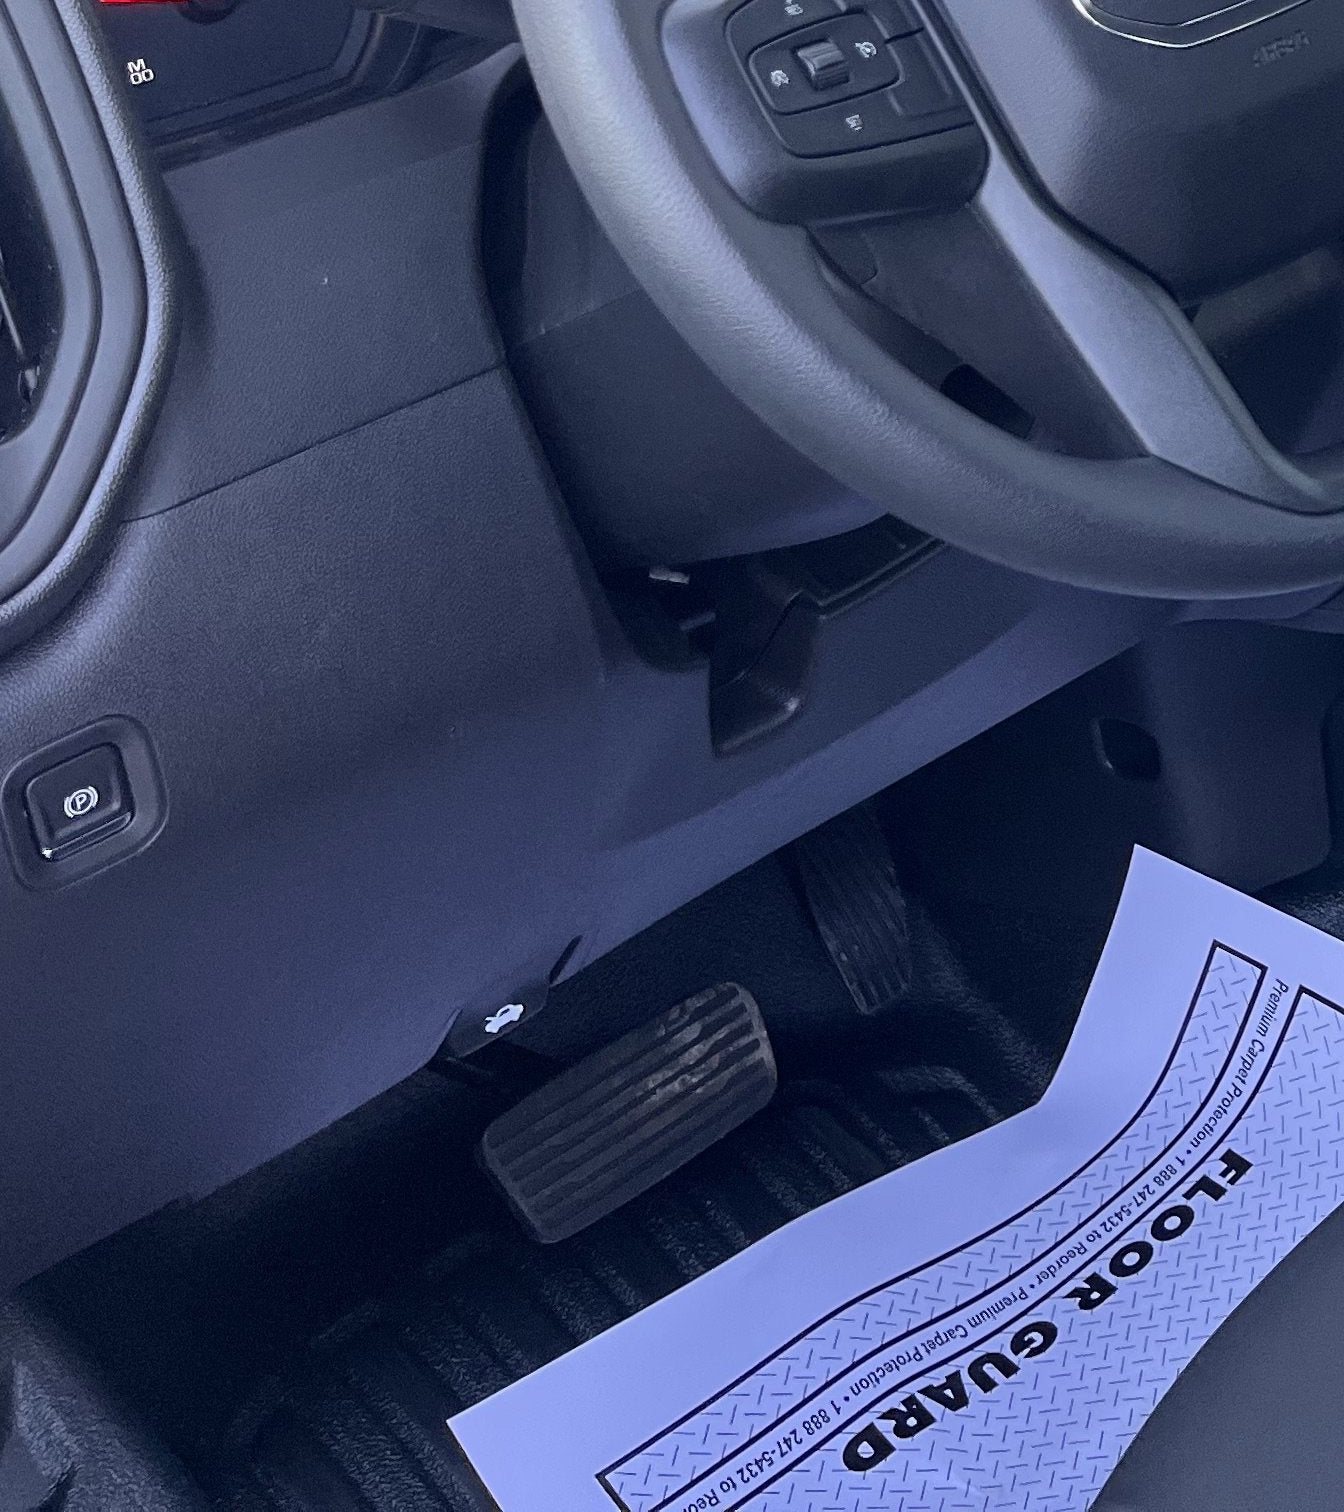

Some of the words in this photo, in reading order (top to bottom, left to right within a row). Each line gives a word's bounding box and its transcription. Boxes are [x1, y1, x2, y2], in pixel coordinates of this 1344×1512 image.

[1256, 978, 1290, 1038] Premium
[1234, 1038, 1266, 1086] Carpet
[1190, 1080, 1244, 1149] Protection
[1153, 1163, 1178, 1188] 888
[1174, 1155, 1187, 1167] 1
[1062, 1147, 1254, 1311] FLOOR
[1099, 1182, 1157, 1234] 247-5432
[1085, 1229, 1101, 1244] to
[1035, 1243, 1089, 1287] Reorder
[966, 1285, 1030, 1329] Premium
[921, 1324, 969, 1357] Carpet
[849, 1345, 924, 1398] Protection
[829, 1399, 843, 1416] 1
[842, 1320, 1059, 1472] GUARD
[802, 1408, 831, 1437] 888
[736, 1427, 804, 1485] 247-5432
[719, 1475, 735, 1494] to
